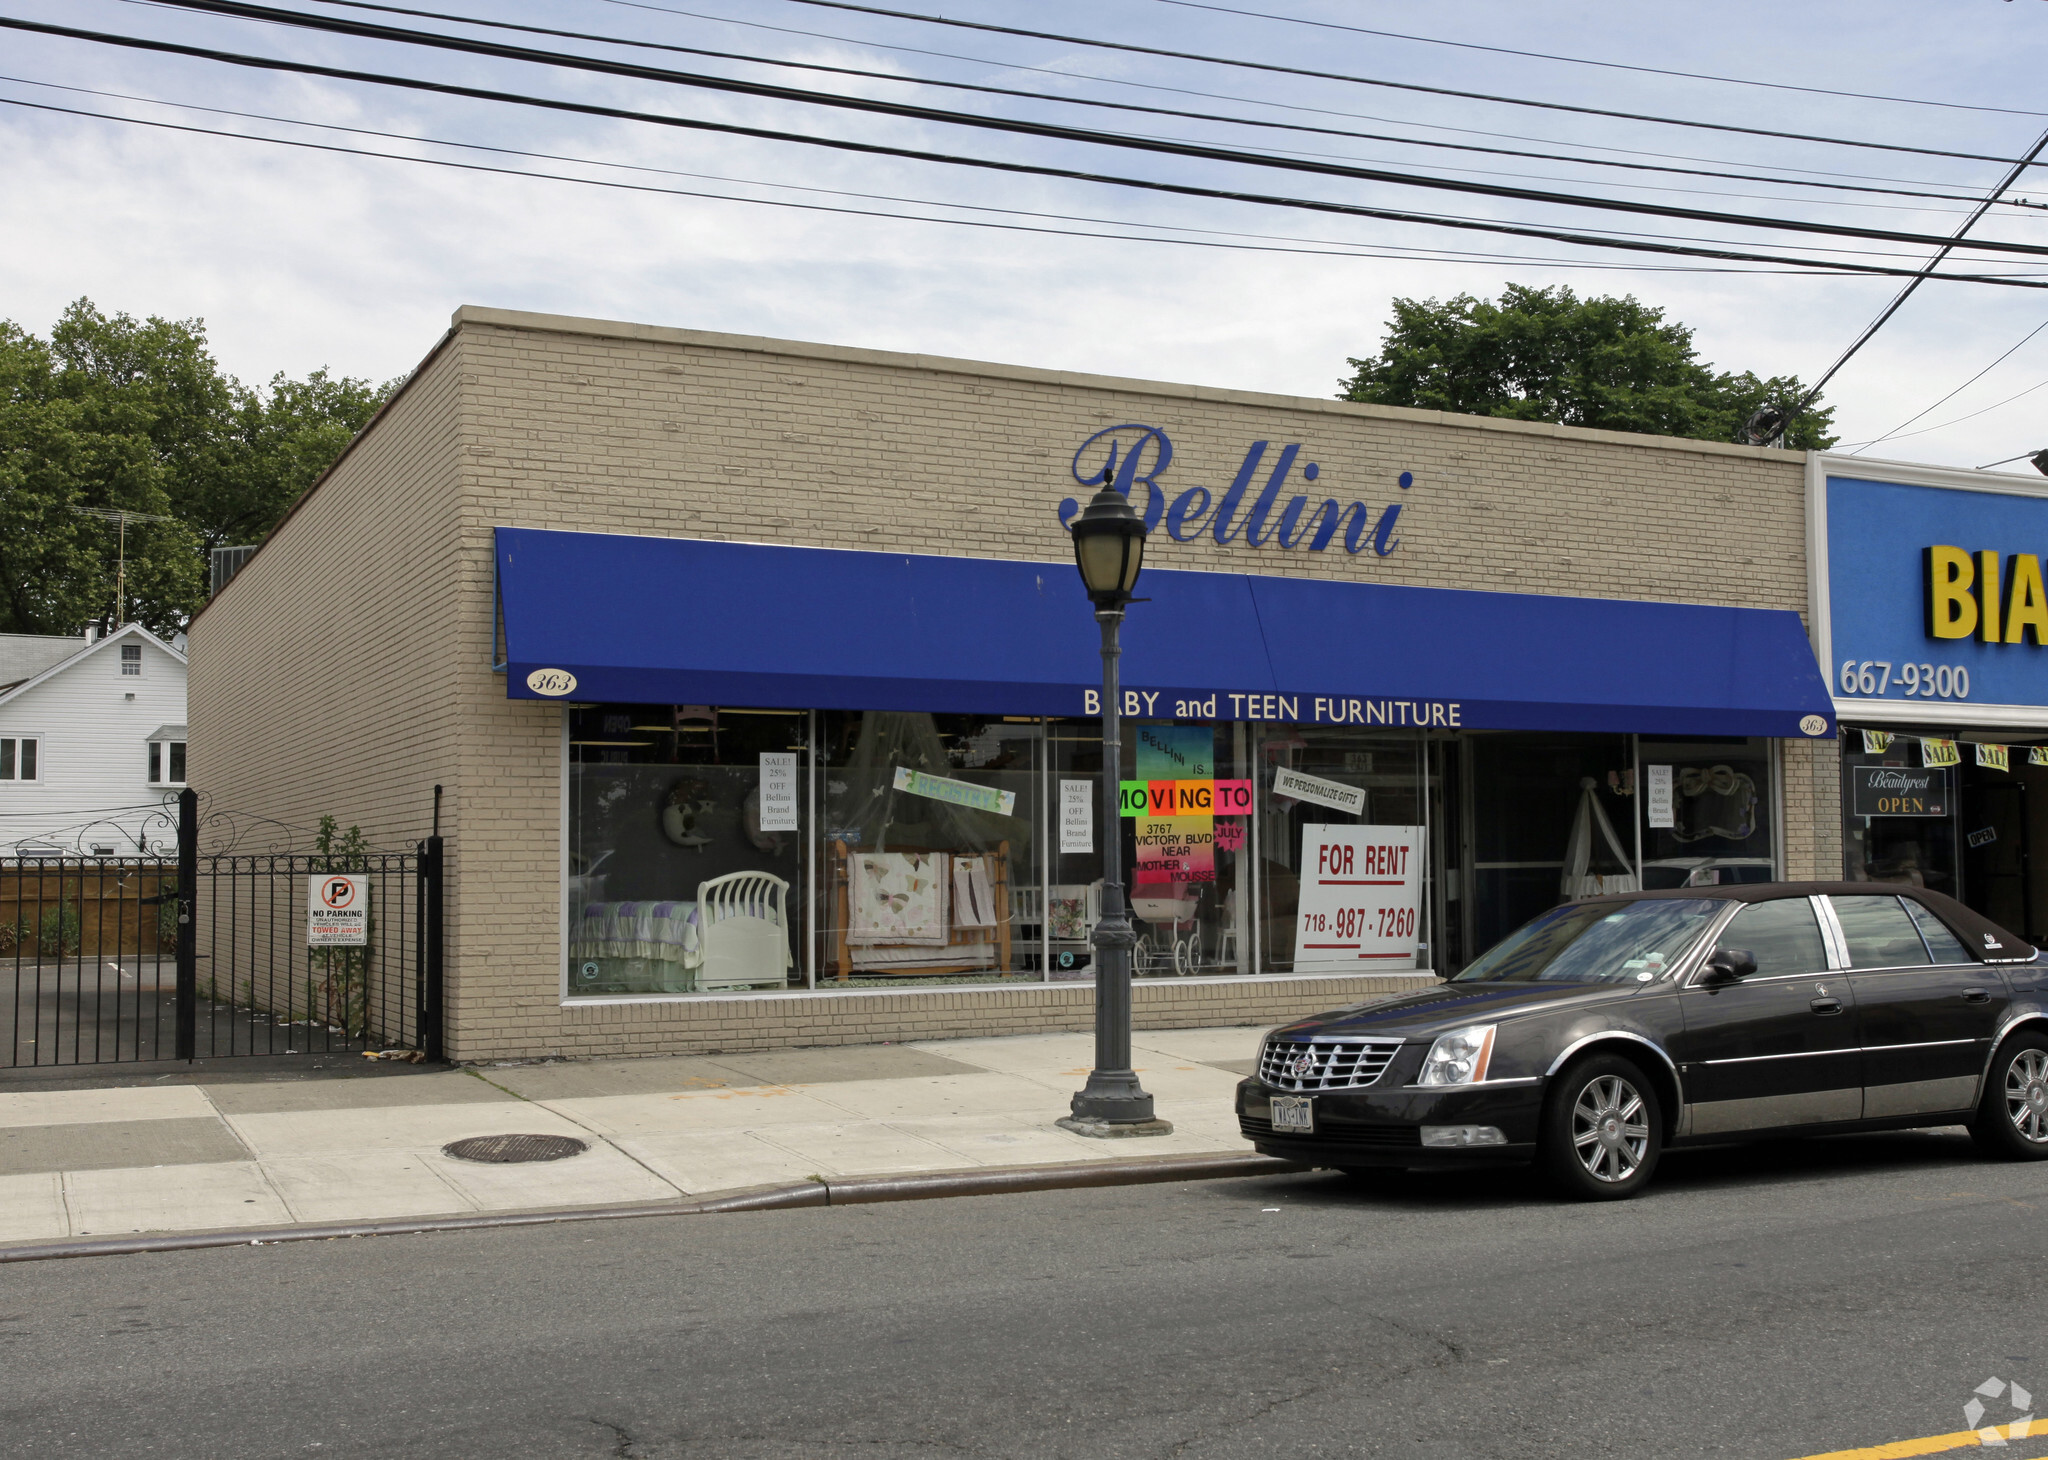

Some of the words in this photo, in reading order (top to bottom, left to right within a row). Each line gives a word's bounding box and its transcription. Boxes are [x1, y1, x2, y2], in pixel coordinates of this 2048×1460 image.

[1058, 424, 1413, 556] Bellini
[532, 673, 571, 691] 363
[1840, 660, 1969, 698] 667-9300
[1084, 689, 1159, 717] BBY
[1175, 693, 1216, 718] and
[1229, 694, 1298, 721] TEEN
[1315, 697, 1461, 728] FURNITURE
[1802, 719, 1825, 732] 363
[1141, 731, 1185, 766] BELLINI
[1924, 743, 1956, 765] SALE
[1978, 744, 2007, 768] SALE
[764, 758, 791, 766] SALE!
[769, 769, 787, 777] 25%
[769, 782, 787, 790] OFF
[1064, 784, 1088, 792] SALE!
[1868, 770, 1930, 796] Beautyrest
[918, 775, 992, 808] REGISTRY
[1282, 775, 1294, 788] WE
[1293, 778, 1338, 801] PERSONALIZE
[1338, 792, 1358, 805] GIFTS
[766, 793, 791, 801] Bellini
[1068, 795, 1084, 803] 25%
[1219, 787, 1250, 808] TO
[767, 806, 790, 814] Brand
[1878, 797, 1924, 813] OPEN
[1068, 807, 1084, 815] OFF
[761, 817, 796, 825] Furniture
[1065, 818, 1088, 826] Bellini
[1066, 829, 1087, 837] Brand
[1146, 823, 1172, 834] 3767
[1217, 828, 1243, 839] JULY
[1136, 835, 1181, 846] VICTORY
[1185, 833, 1213, 845] BLVD
[1969, 827, 1995, 846] OPEN
[1061, 840, 1092, 848] Furniture
[1162, 846, 1191, 857] NEAR
[1319, 844, 1354, 875] FOR
[1365, 845, 1409, 875] RENT
[1137, 860, 1180, 871] MOTHER
[1170, 871, 1215, 882] MOUSSE
